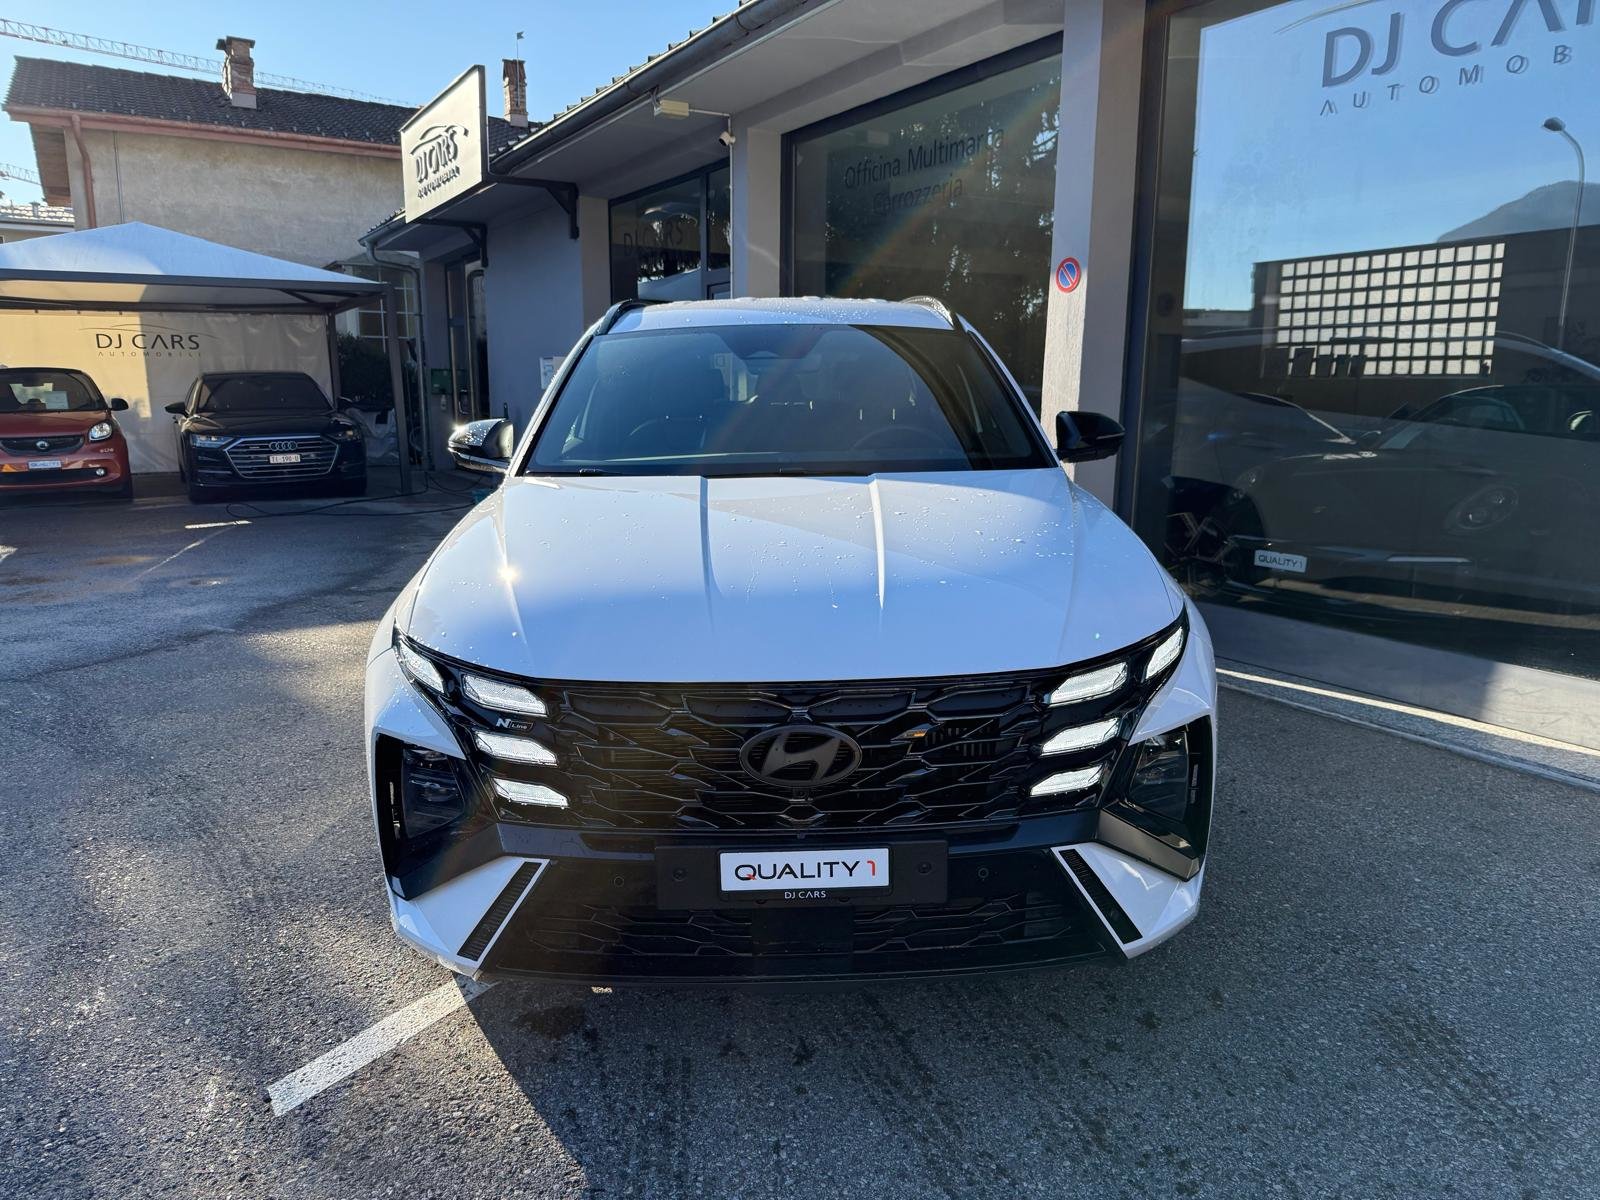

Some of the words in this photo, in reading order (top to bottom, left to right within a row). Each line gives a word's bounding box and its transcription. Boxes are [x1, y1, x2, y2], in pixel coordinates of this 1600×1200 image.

[1322, 12, 1403, 88] DJ
[1431, 0, 1594, 56] CA
[844, 153, 902, 189] Officina
[96, 333, 122, 349] DJ
[132, 333, 200, 350] CARS
[1258, 554, 1297, 567] QUALITY
[734, 860, 860, 881] QUALITY
[866, 860, 876, 877] 1
[784, 891, 796, 899] DJ
[798, 890, 827, 899] CARS
